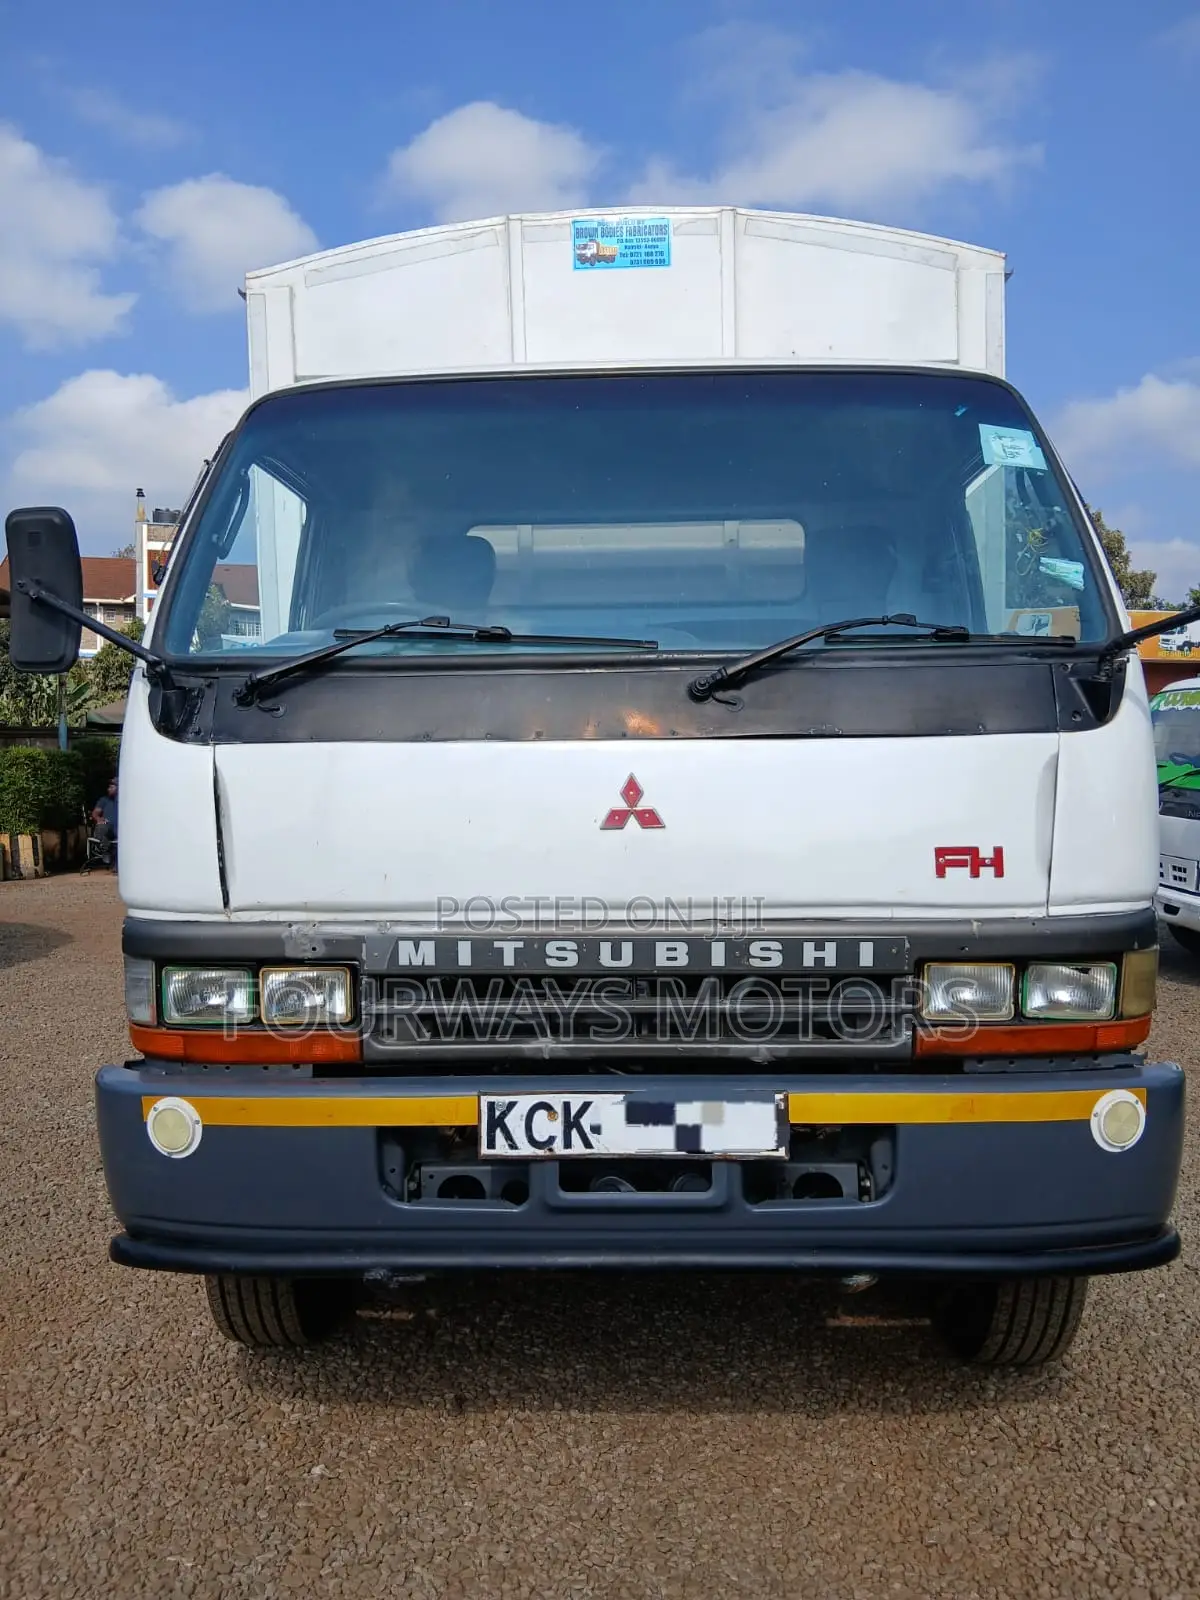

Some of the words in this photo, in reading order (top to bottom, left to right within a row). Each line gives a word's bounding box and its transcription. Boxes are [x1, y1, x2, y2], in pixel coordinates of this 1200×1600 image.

[600, 226, 624, 238] BODIES
[625, 224, 669, 237] FABRICATORS
[934, 845, 1004, 879] FH
[397, 940, 875, 968] MITSUBISHI
